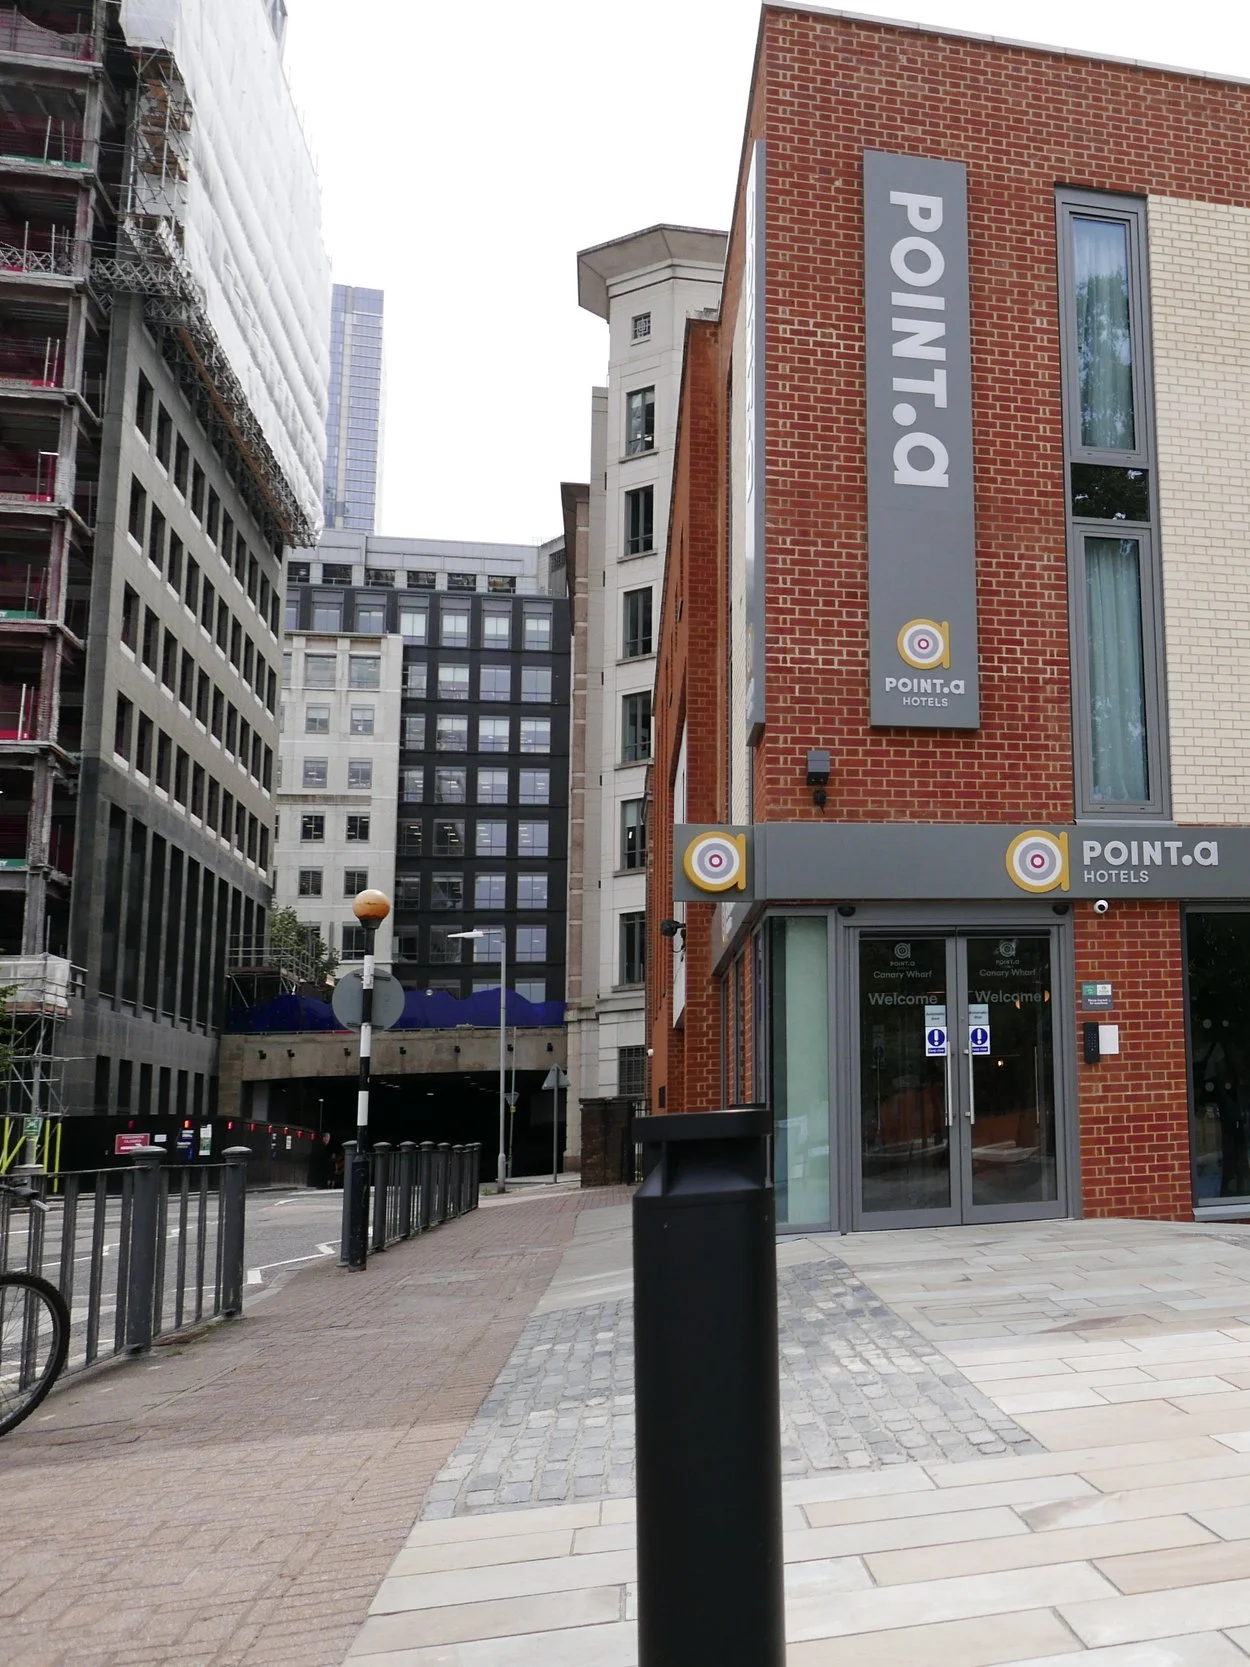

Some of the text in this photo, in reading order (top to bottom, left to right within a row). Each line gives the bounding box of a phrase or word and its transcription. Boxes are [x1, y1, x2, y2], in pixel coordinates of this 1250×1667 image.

[890, 191, 949, 488] POINT.a
[885, 677, 965, 694] POINT.a
[902, 697, 949, 707] HOTELS
[1082, 840, 1219, 866] POINT.a
[1083, 870, 1150, 883] HOTELS
[873, 970, 933, 980] Canary Wharf
[979, 968, 1037, 978] Canary Wharf
[868, 992, 938, 1006] Welcome
[975, 990, 1042, 1003] Welcome
